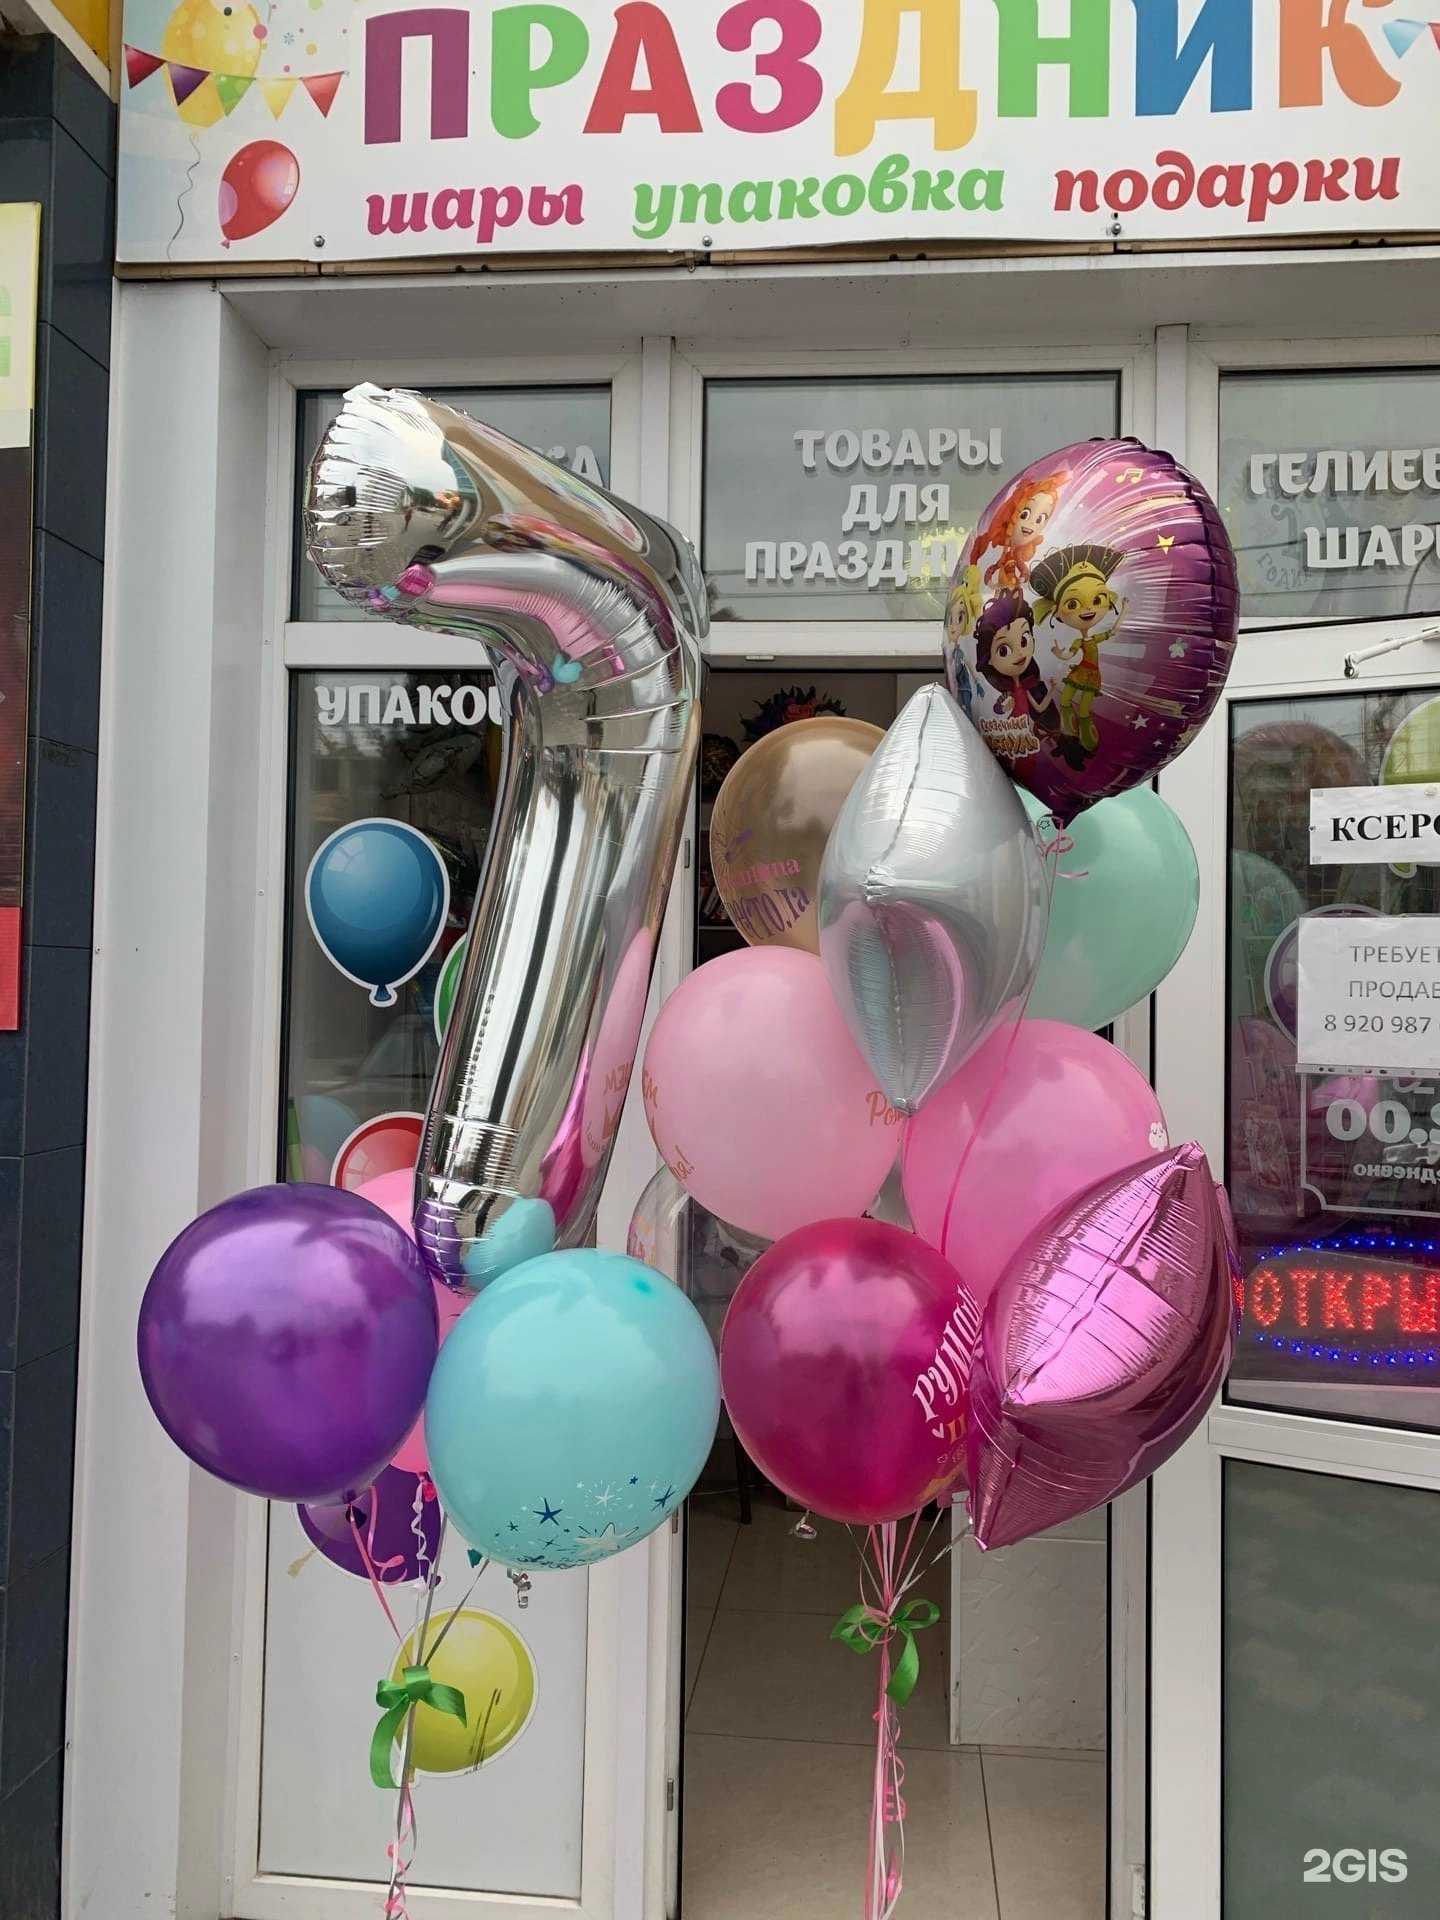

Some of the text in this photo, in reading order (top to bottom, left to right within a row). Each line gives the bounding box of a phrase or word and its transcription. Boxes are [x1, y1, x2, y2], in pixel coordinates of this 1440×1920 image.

[364, 0, 1402, 156] ПРАЗДНИК
[366, 150, 1401, 243] шары упаковка подарки
[793, 428, 1004, 468] ТОВАРЫ
[842, 484, 950, 532] ДЛЯ
[1304, 524, 1440, 568] ШАР
[1331, 813, 1440, 843] КСЕР
[1324, 1015, 1337, 1032] 8
[1344, 1015, 1384, 1033] 920
[1391, 1016, 1432, 1034] 987
[1252, 1270, 1440, 1334] ОТКРЫ
